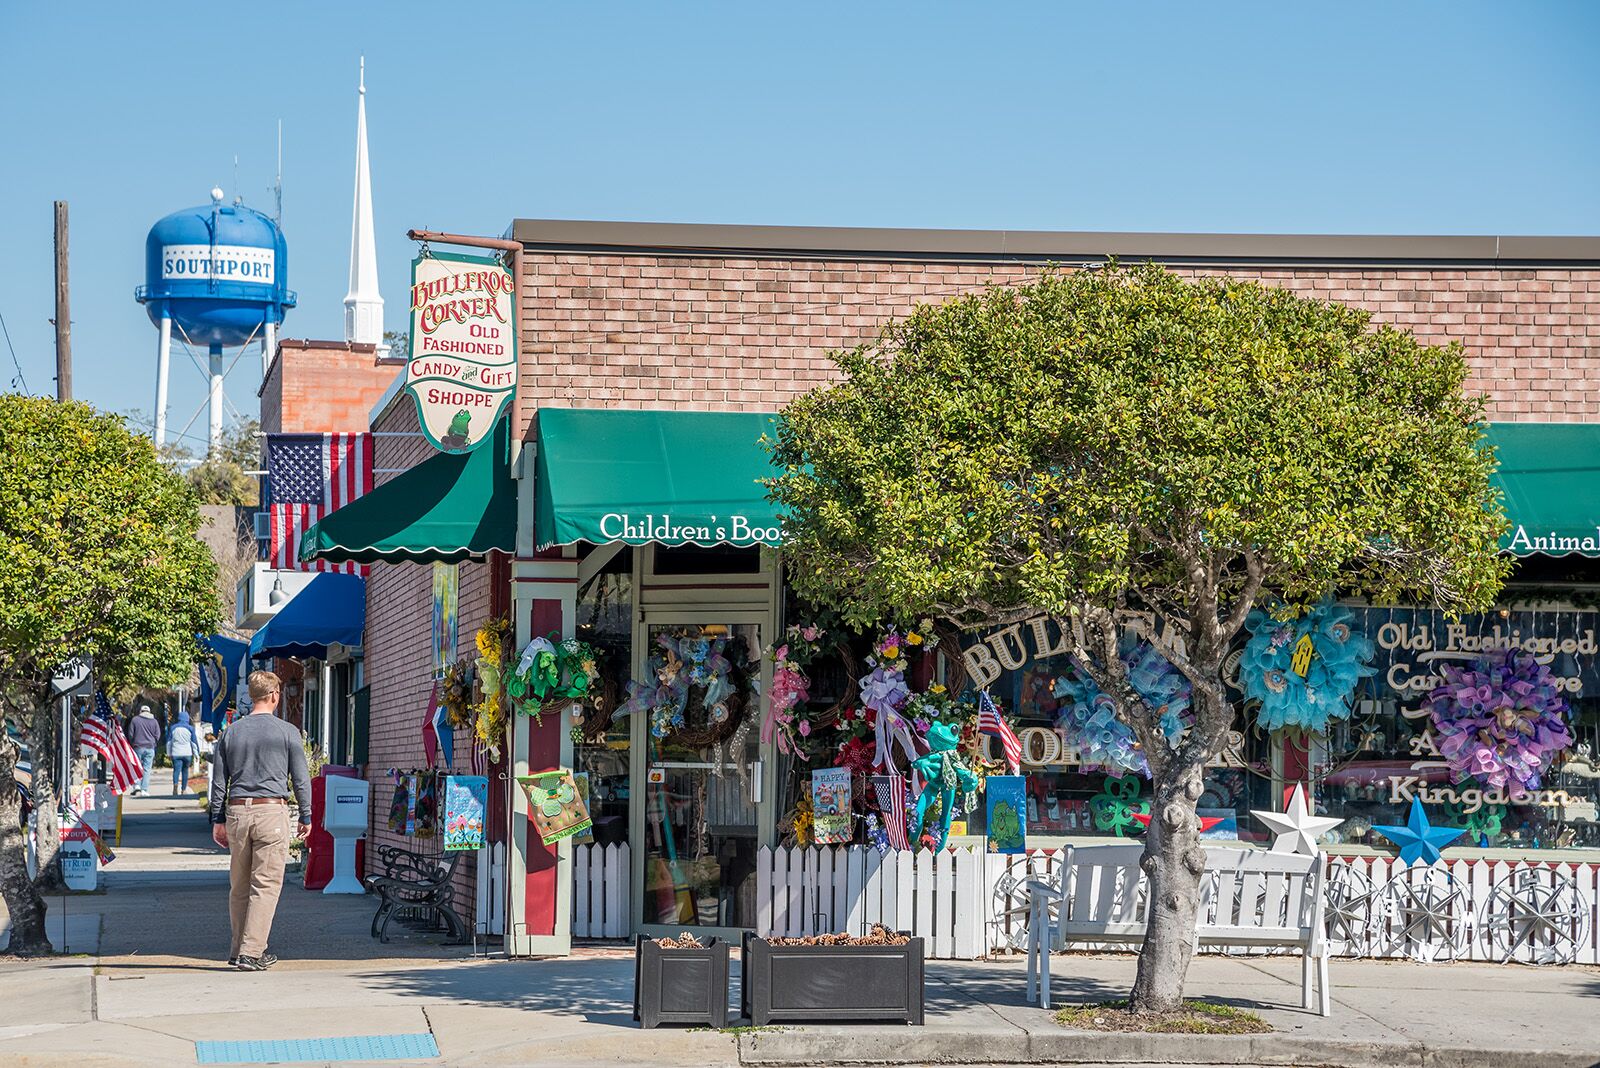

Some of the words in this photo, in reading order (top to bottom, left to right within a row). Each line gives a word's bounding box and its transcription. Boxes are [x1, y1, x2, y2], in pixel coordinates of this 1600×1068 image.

[165, 258, 272, 278] SOUTHPORT
[410, 271, 514, 309] BULLFROG
[420, 297, 507, 334] CORNER
[469, 324, 499, 339] OLD
[423, 337, 504, 356] FASHIONED
[411, 360, 461, 377] CANDY
[461, 367, 478, 381] and
[480, 368, 512, 386] GIFT
[428, 388, 493, 408] SHOPPE
[600, 513, 726, 541] Children's
[1377, 623, 1432, 650] Old
[1445, 624, 1597, 656] Fashioned
[820, 773, 845, 782] HAPPY
[1388, 776, 1571, 814] Kingdom
